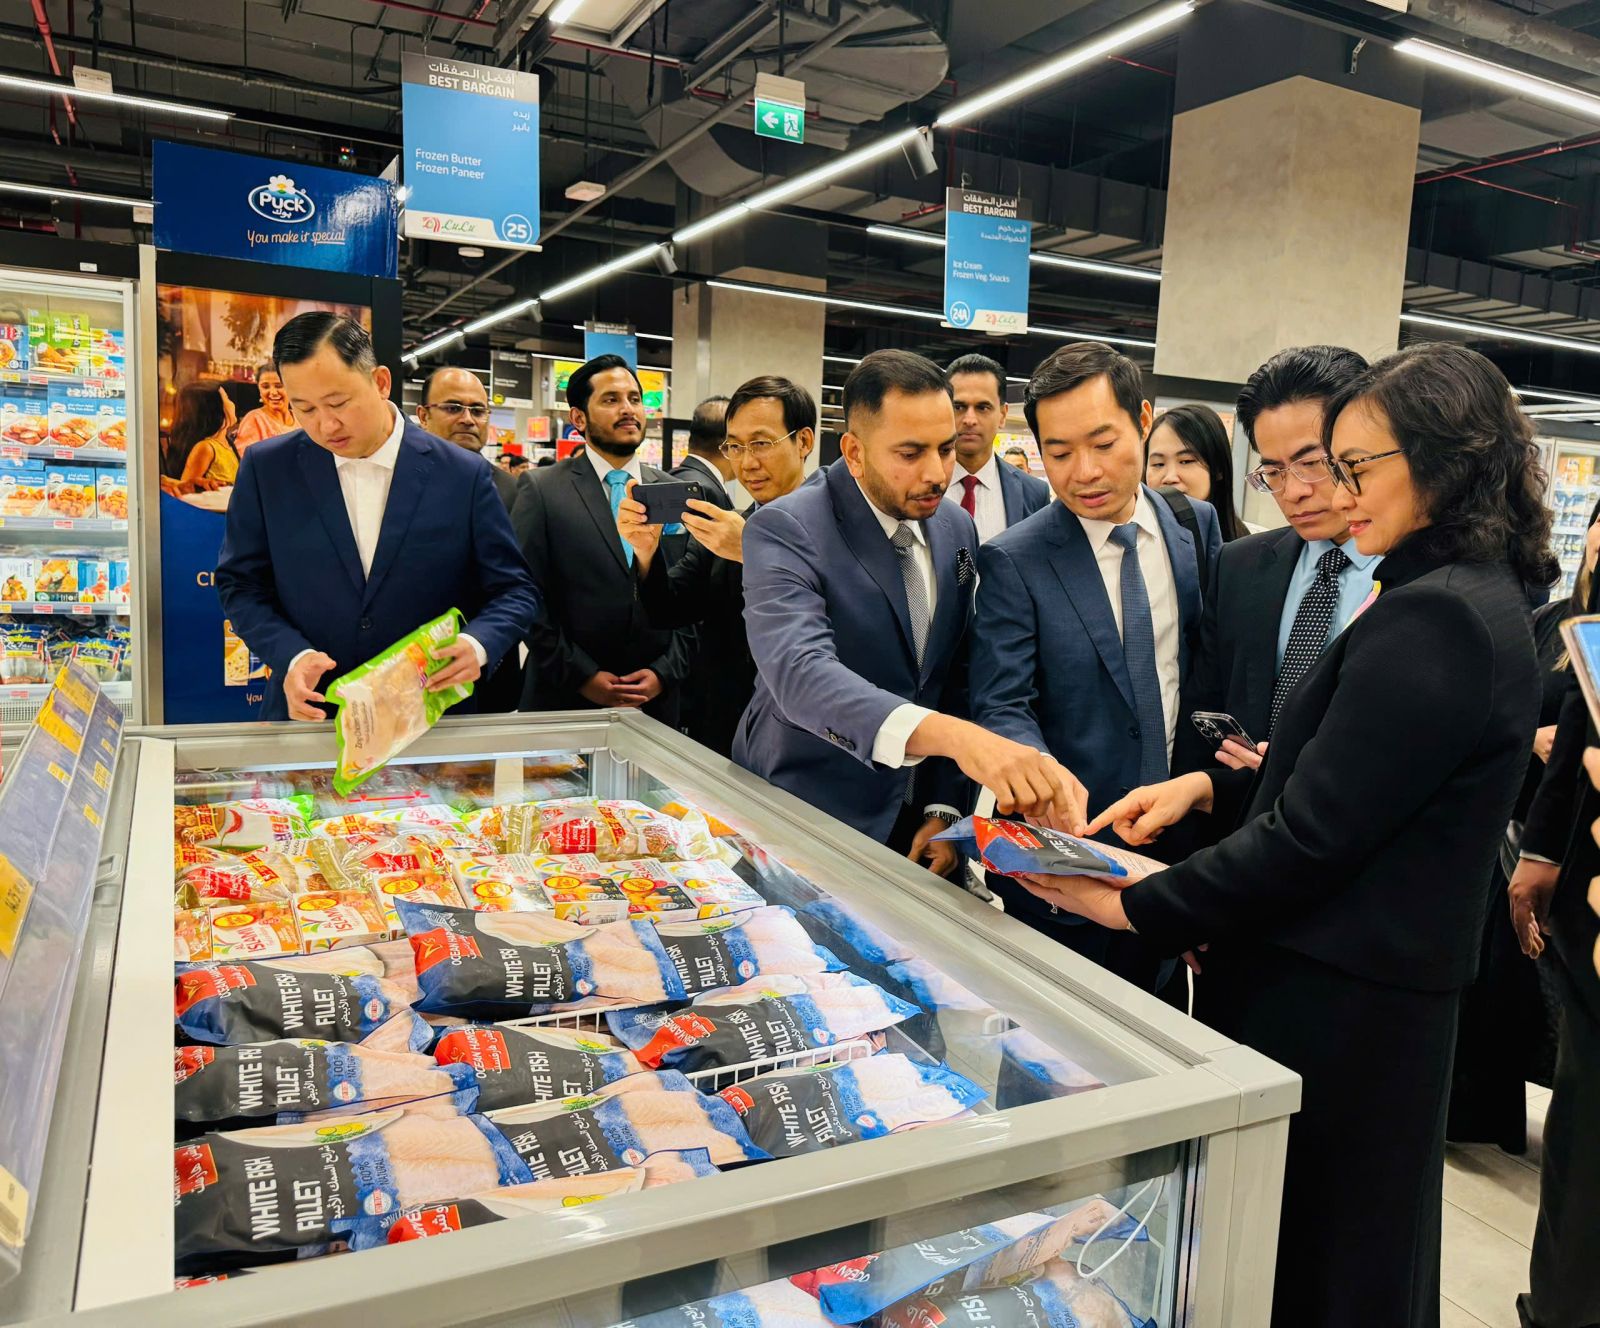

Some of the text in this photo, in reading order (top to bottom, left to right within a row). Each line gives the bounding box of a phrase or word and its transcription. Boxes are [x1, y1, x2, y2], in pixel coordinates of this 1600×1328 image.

[428, 62, 480, 78] الصفقات
[428, 74, 515, 99] BEST BARGAIN
[415, 148, 482, 167] Frozen Butter
[415, 161, 485, 180] Frozen Paneer
[963, 203, 1017, 219] BEST BARGAIN
[247, 228, 345, 247] You make it special
[507, 222, 528, 239] 25
[953, 260, 962, 268] Ice
[953, 270, 975, 279] Frozen
[504, 960, 525, 998] WHITE
[532, 962, 552, 998] FILLET
[694, 956, 717, 988] FILLET
[280, 987, 304, 1030] WHITE
[313, 988, 336, 1026] FILLET
[738, 1022, 768, 1059] WHITE
[766, 1020, 794, 1056] FILLET
[471, 1051, 487, 1079] OCEAN
[527, 1051, 553, 1103] HITE FISH
[239, 1062, 264, 1110] WHITE
[276, 1065, 301, 1105] FILLET
[303, 1081, 320, 1106] الأبيض
[763, 1080, 808, 1149] WHITE FISH
[805, 1106, 836, 1143] FILLET
[510, 1130, 541, 1154] FISH
[323, 1164, 340, 1192] السمك
[358, 1161, 375, 1187] 100%
[374, 1158, 390, 1186] NATURAL
[243, 1156, 281, 1240] WHITE FISH
[293, 1179, 325, 1233] FILLET
